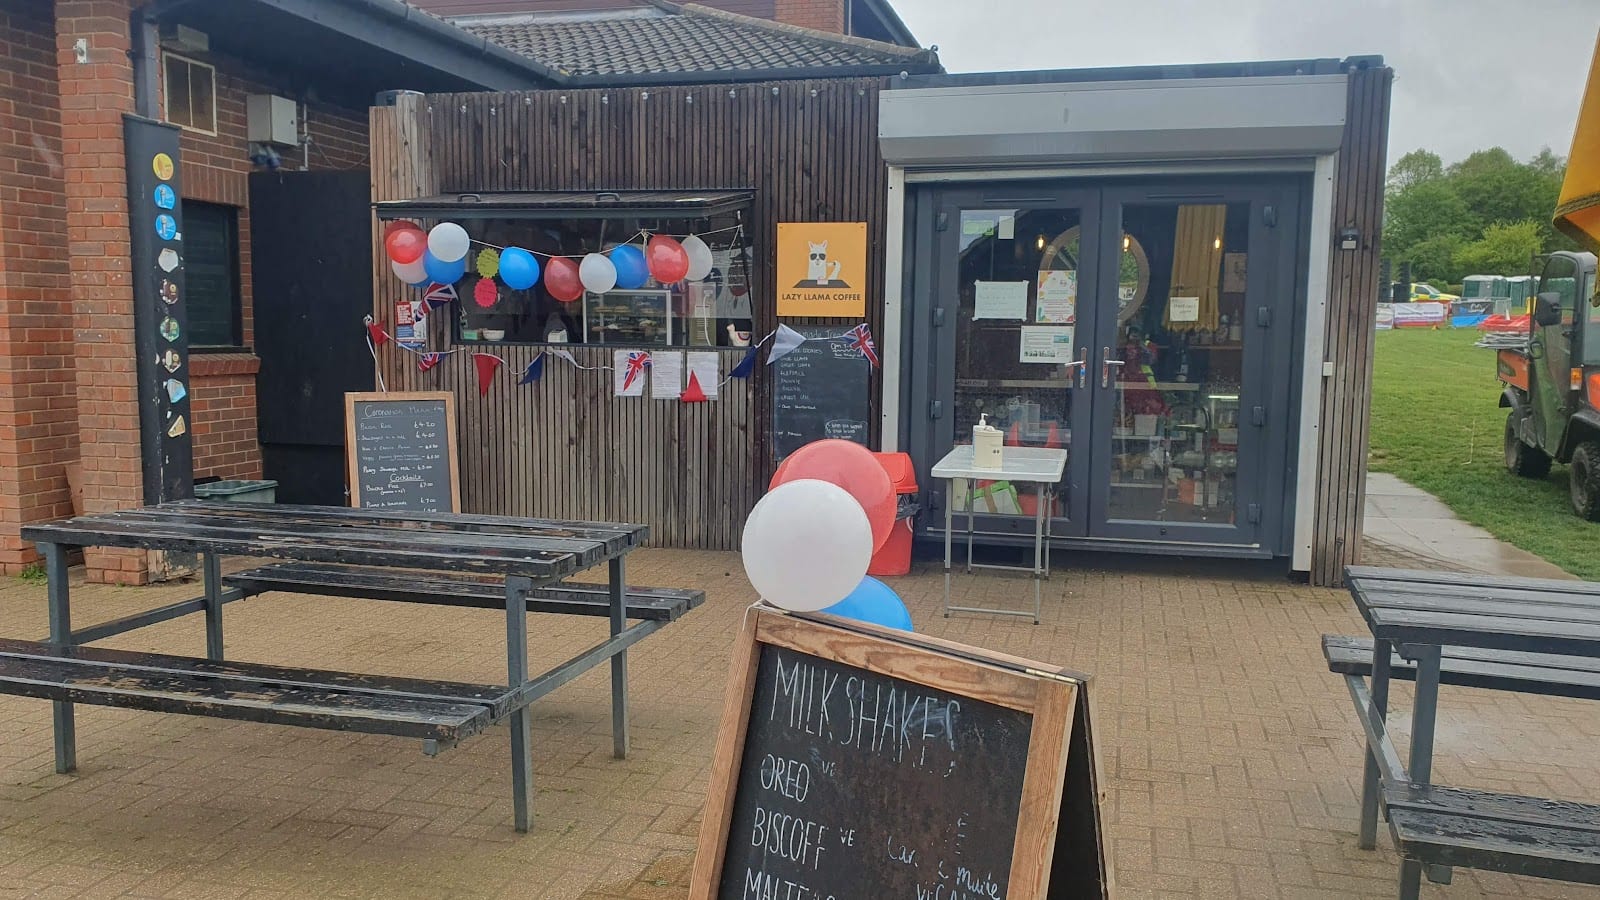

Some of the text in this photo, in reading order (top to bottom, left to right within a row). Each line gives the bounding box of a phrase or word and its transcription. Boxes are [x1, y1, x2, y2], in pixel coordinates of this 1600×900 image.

[782, 293, 861, 301] LAZY LLAMA COFFEE
[364, 404, 403, 418] Coronation
[390, 474, 422, 482] Cocktails
[760, 753, 810, 802] OREO
